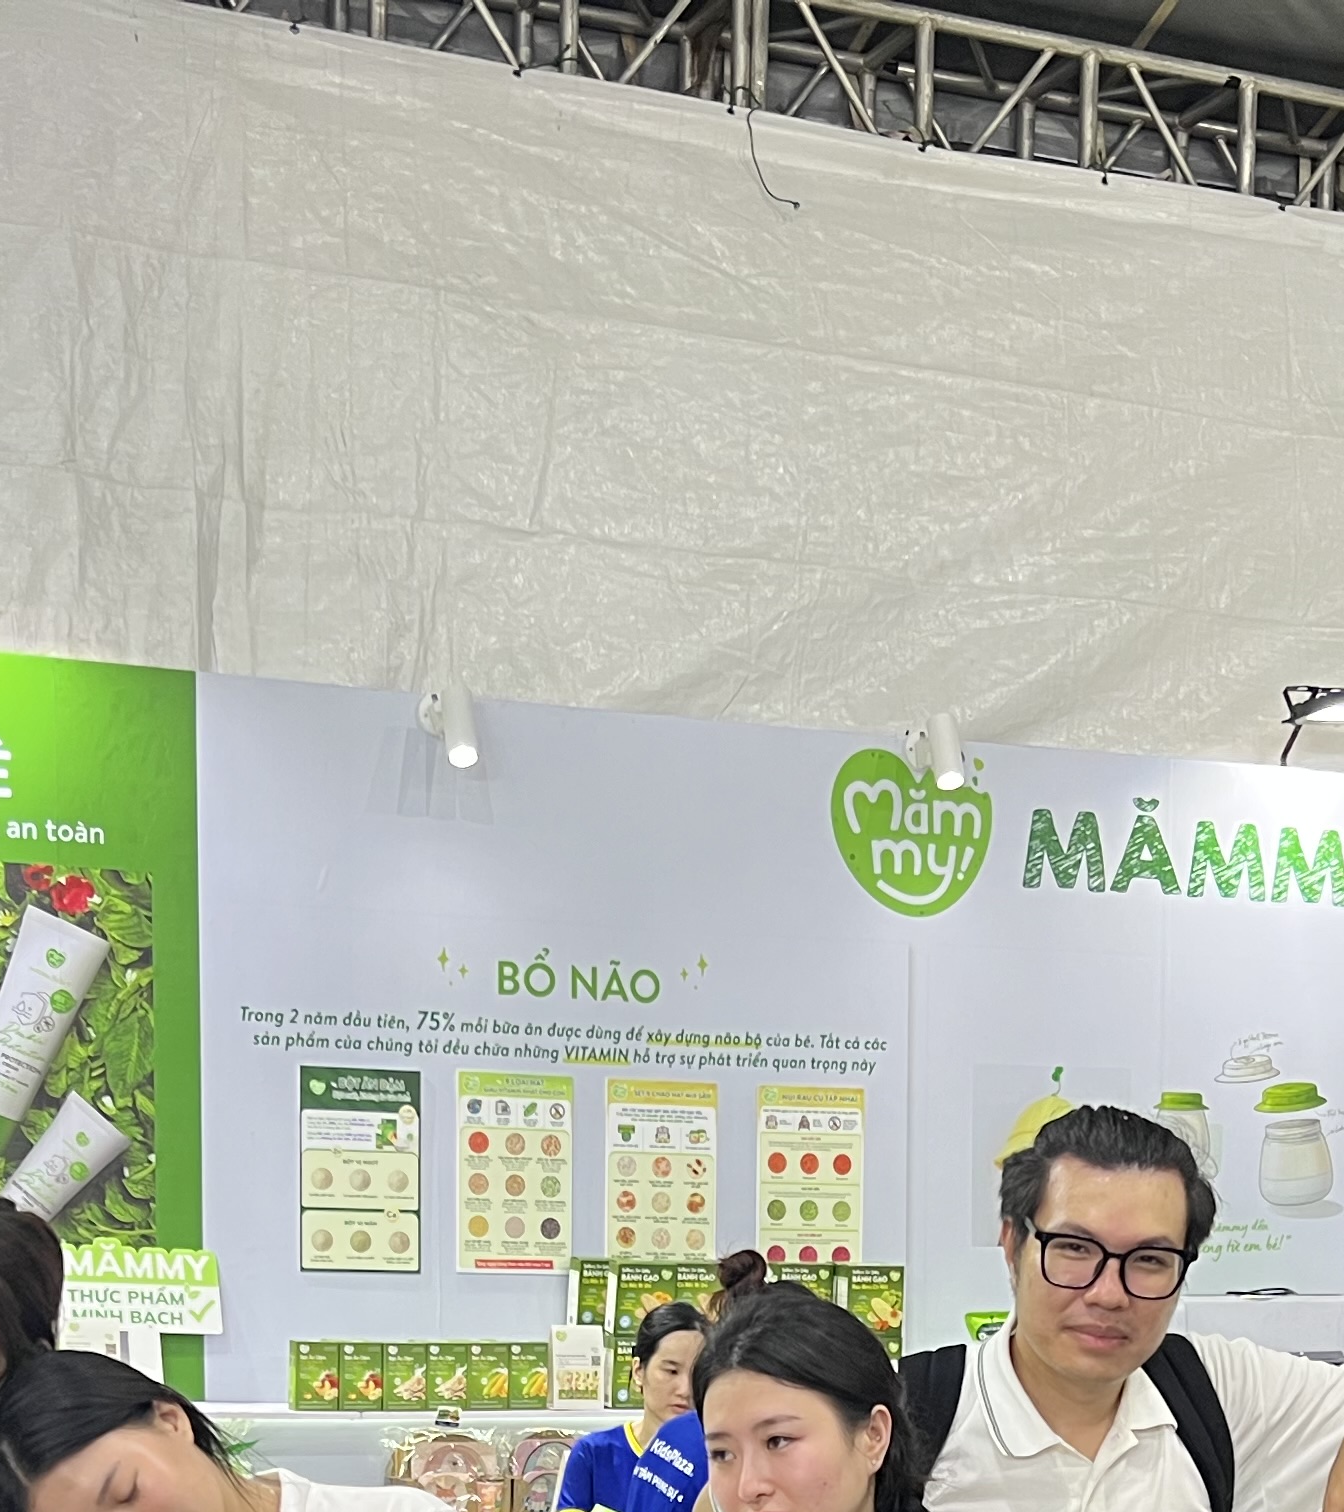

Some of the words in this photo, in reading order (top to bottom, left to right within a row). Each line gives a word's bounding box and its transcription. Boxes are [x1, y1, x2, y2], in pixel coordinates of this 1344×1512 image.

[7, 821, 37, 840] an
[45, 819, 105, 845] toàn
[497, 948, 556, 997] BỔ
[570, 960, 660, 1004] NÃO
[241, 1006, 284, 1027] Trong
[289, 1008, 299, 1024] 2
[304, 1012, 337, 1026] năm
[416, 1010, 455, 1032] 75%
[586, 1024, 621, 1044] dùng
[646, 1029, 671, 1046] xây
[676, 1028, 710, 1048] dựng
[744, 1031, 762, 1049] bộ
[766, 1033, 790, 1047] của
[864, 1038, 887, 1051] các
[253, 1031, 280, 1046] sản
[285, 1031, 329, 1051] phẩm
[335, 1035, 361, 1050] của
[367, 1036, 413, 1057] chúng
[418, 1039, 438, 1053] tôi
[564, 1045, 629, 1063] VITAMIN
[698, 1051, 731, 1070] phát
[773, 1058, 806, 1073] quan
[811, 1057, 847, 1074] trọng
[851, 1058, 876, 1076] này
[64, 1242, 210, 1281] MĂMMY
[67, 1288, 120, 1307] THỰC
[128, 1287, 185, 1306] PHẨM
[130, 1310, 183, 1328] BẠCH
